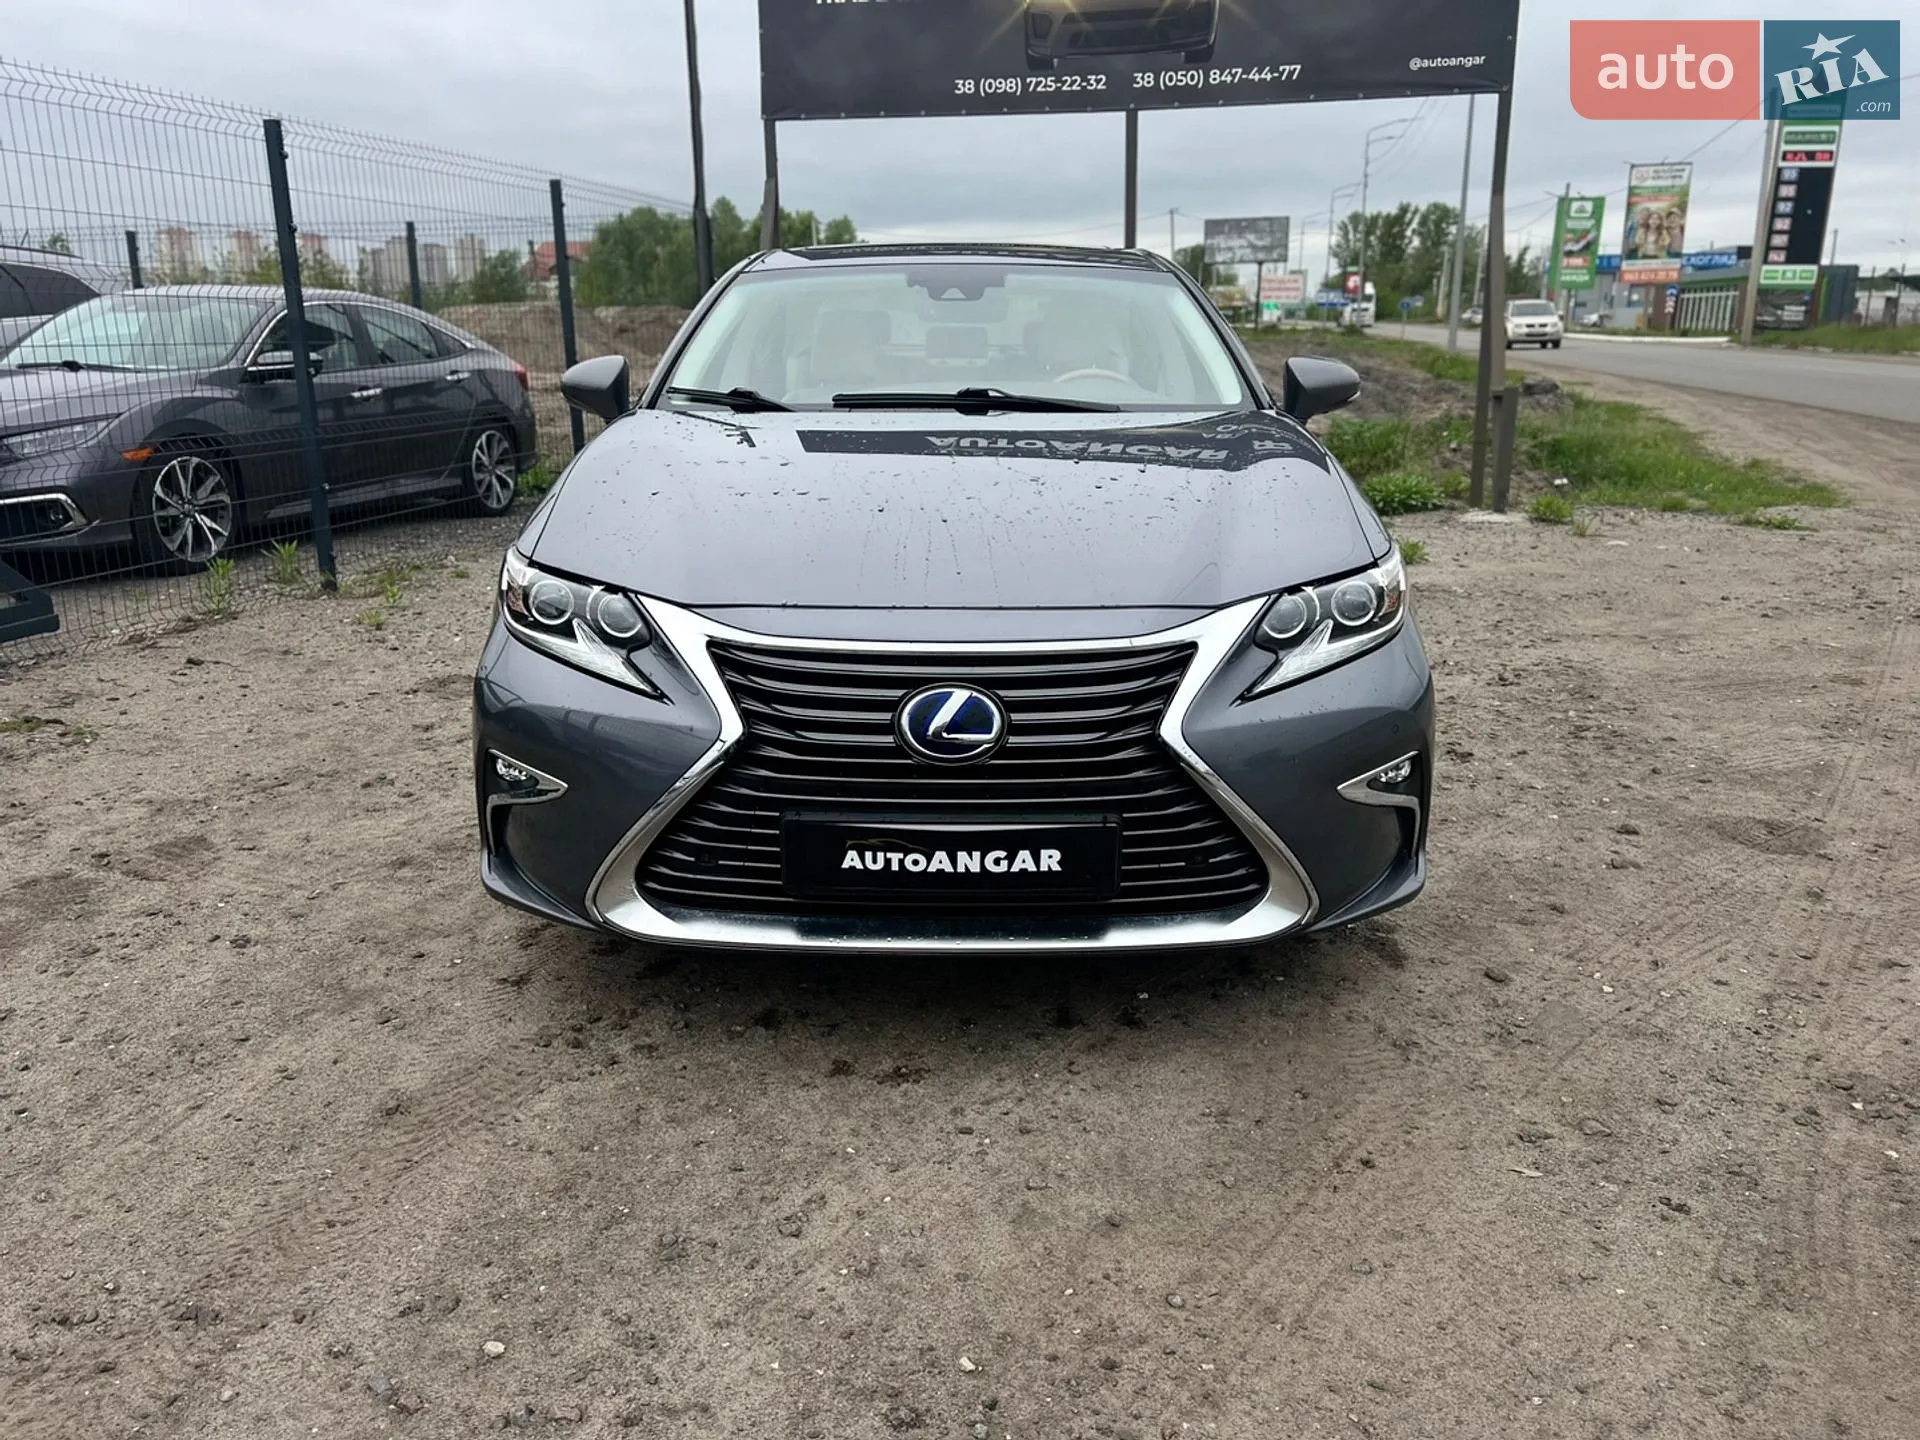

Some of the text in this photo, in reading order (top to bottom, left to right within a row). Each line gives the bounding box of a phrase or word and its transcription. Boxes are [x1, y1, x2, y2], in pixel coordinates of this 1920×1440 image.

[1409, 55, 1486, 71] @autoangar
[954, 75, 1107, 97] 38 (098) 725-22-32
[1132, 64, 1302, 91] 38 (050) 847-44-77
